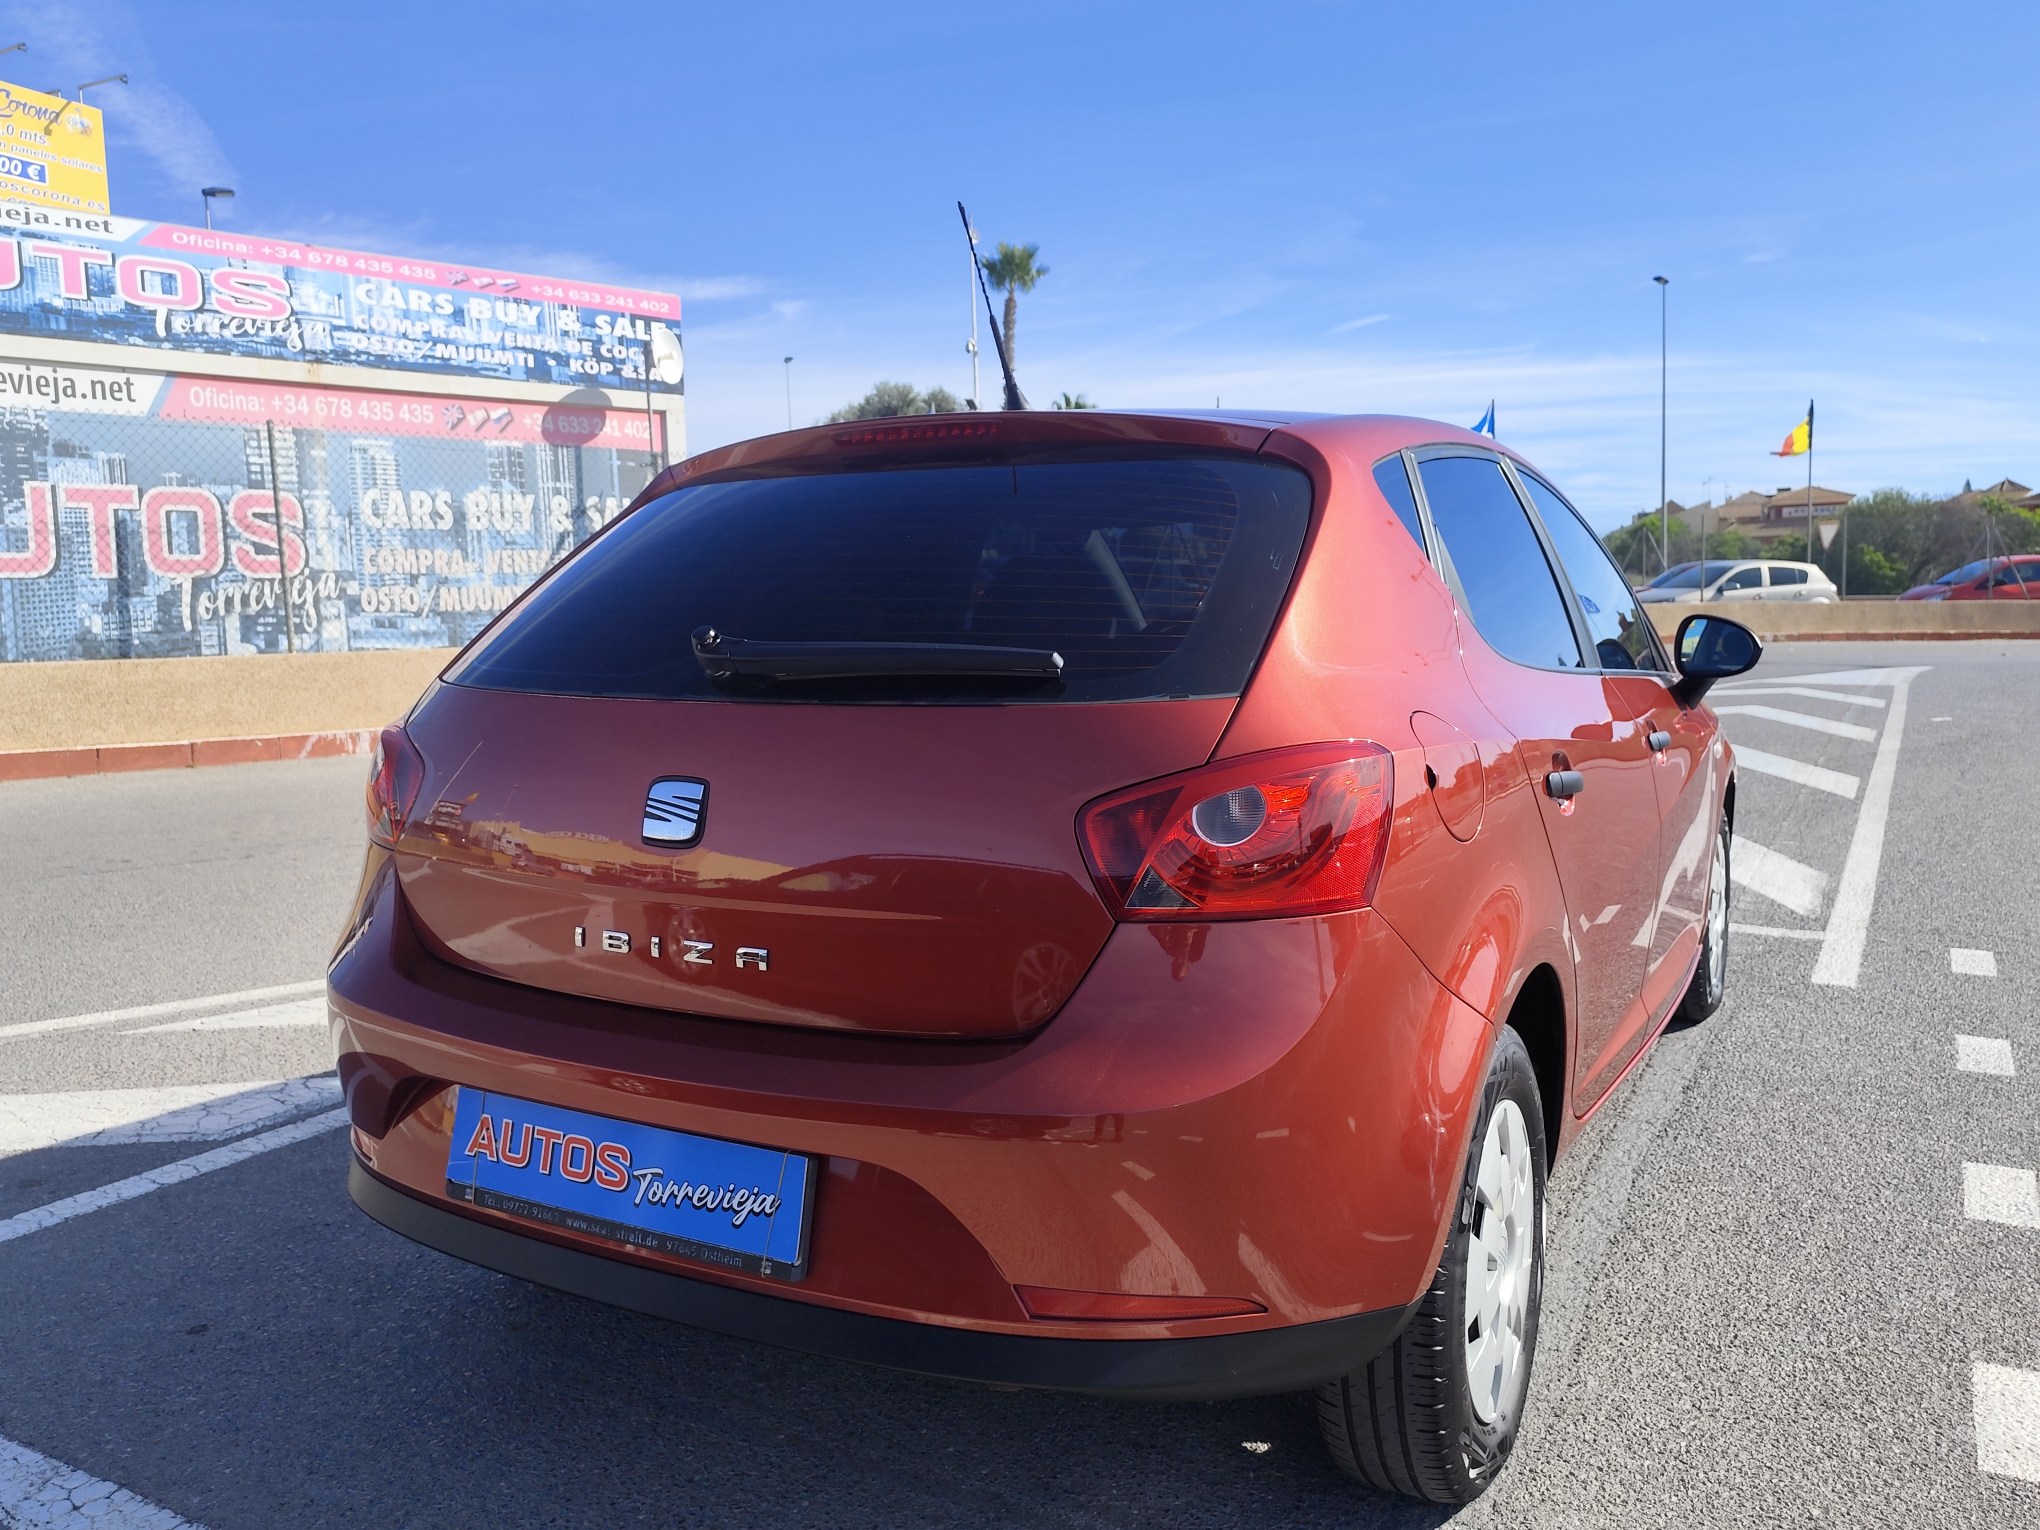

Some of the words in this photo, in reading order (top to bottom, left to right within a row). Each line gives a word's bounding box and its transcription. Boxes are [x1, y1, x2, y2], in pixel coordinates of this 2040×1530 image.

[10, 143, 58, 162] paneles
[61, 157, 103, 173] solares
[27, 164, 42, 181] €
[172, 231, 254, 255] Oficina:
[261, 244, 302, 261] +34
[308, 251, 349, 268] 678
[355, 257, 393, 274] 435
[399, 264, 437, 281] 435
[356, 283, 455, 316] CARS
[469, 297, 543, 326] BUY
[558, 309, 582, 333] &
[531, 284, 564, 299] +34
[568, 289, 601, 304] 633
[605, 294, 636, 309] 241
[639, 298, 670, 314] 402
[355, 314, 464, 341] COMPRA
[485, 329, 559, 354] VENTA
[566, 339, 593, 356] DE
[569, 356, 615, 376] KÖP
[189, 386, 266, 413] Oficina:
[271, 393, 310, 416] +34
[314, 395, 354, 418] 678
[357, 399, 395, 422] 435
[399, 402, 435, 425] 435
[522, 412, 555, 434] +34
[558, 415, 591, 435] 633
[593, 417, 622, 437] 241
[624, 419, 651, 440] 402
[361, 488, 455, 532] CARS
[465, 490, 536, 533] BUY
[550, 494, 574, 533] &
[584, 495, 631, 533] SA
[363, 548, 466, 576] COMPRA
[170, 567, 343, 634] Torreveja
[574, 925, 769, 972] IBIZA
[464, 1113, 632, 1193] AUTOS
[632, 1167, 783, 1227] Torrevieja
